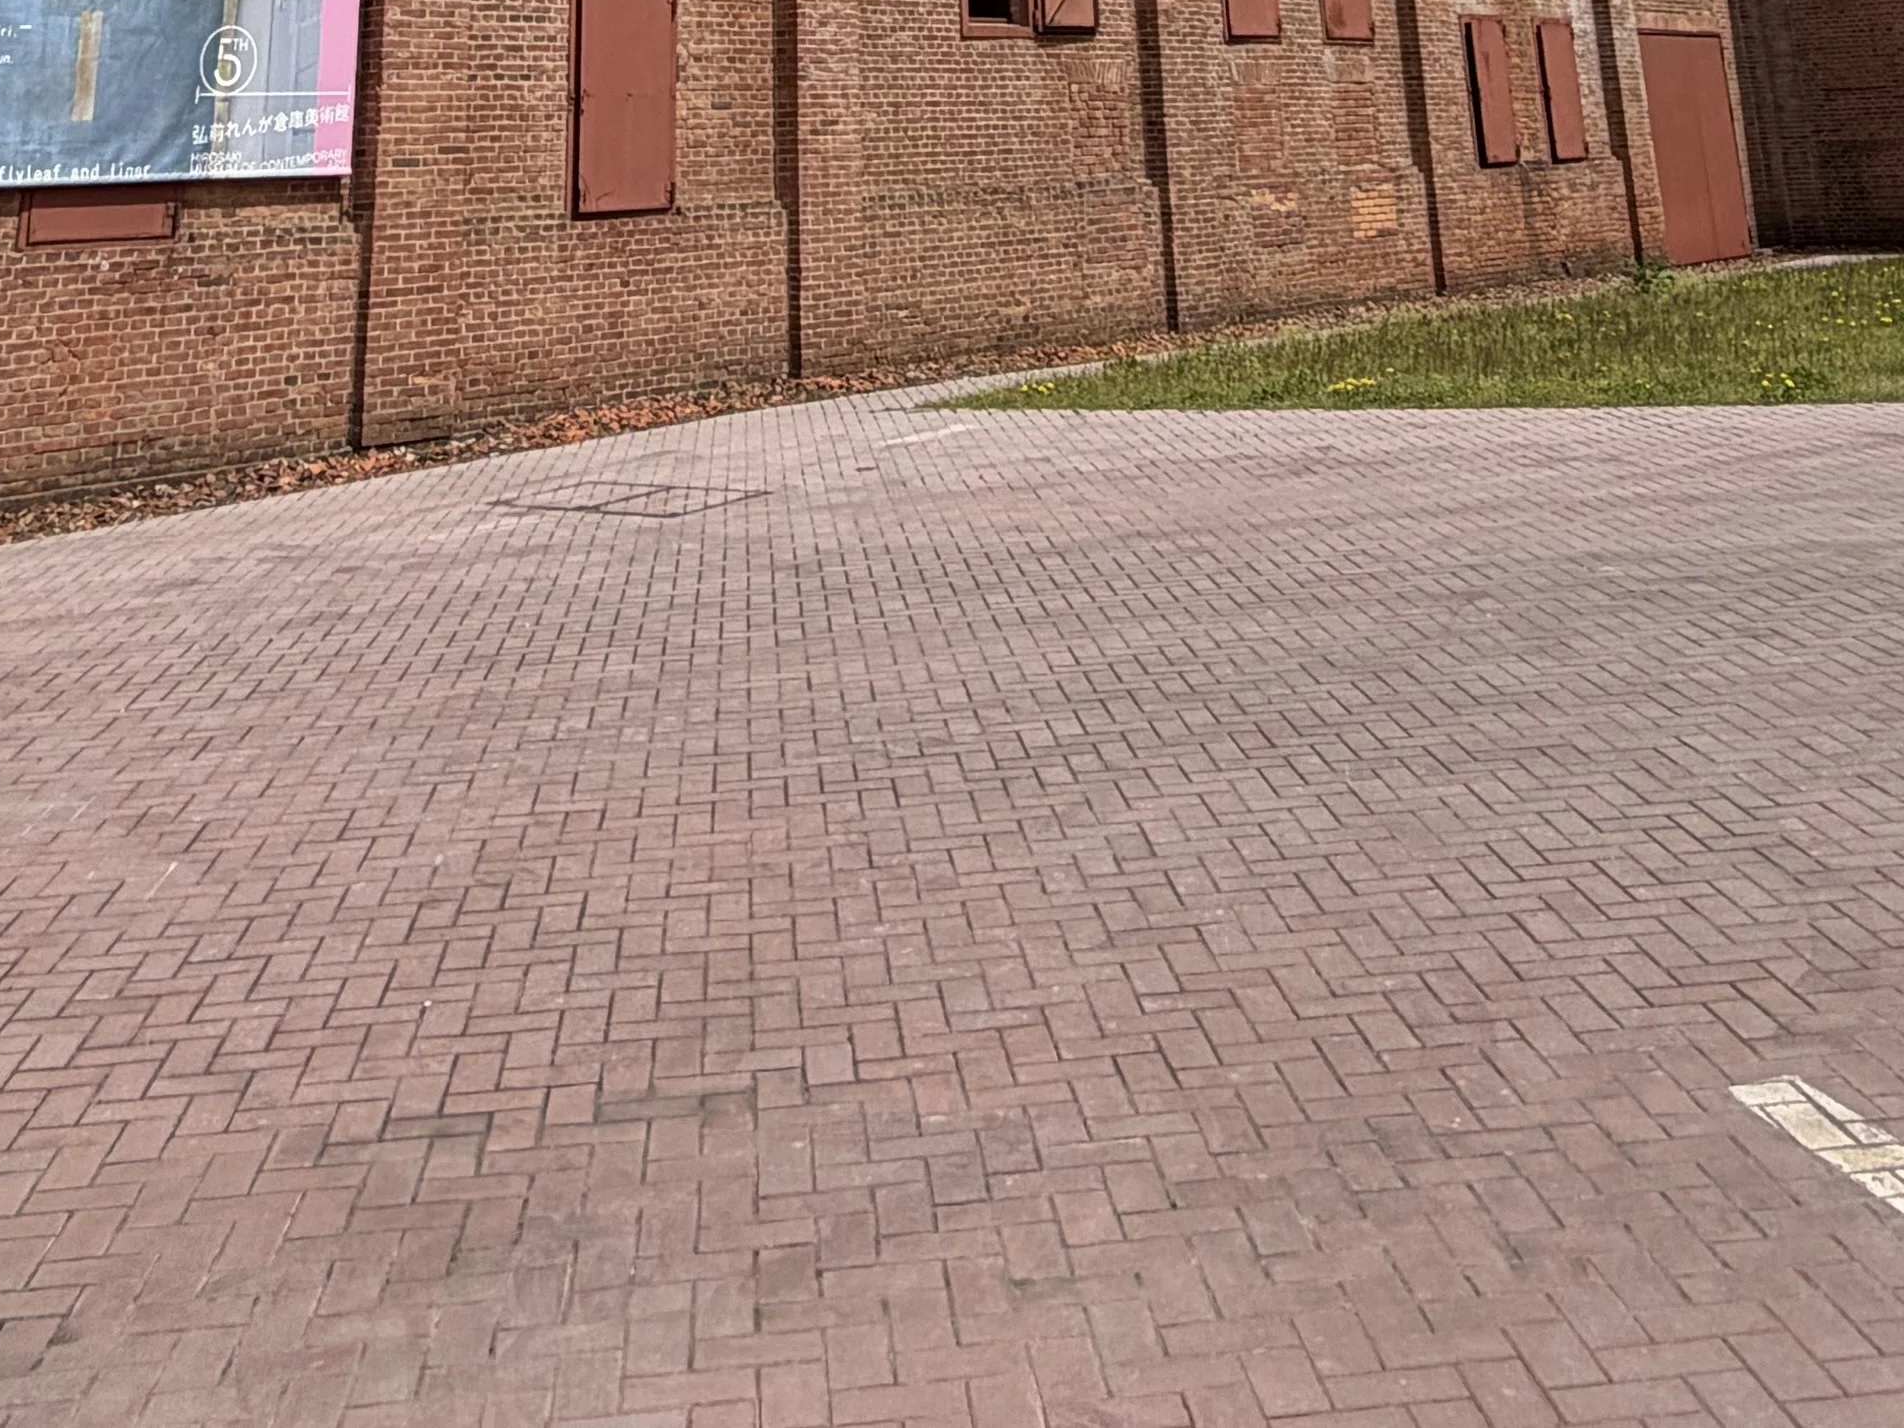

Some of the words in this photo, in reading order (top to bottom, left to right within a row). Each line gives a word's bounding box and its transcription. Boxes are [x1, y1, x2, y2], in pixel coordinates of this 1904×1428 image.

[191, 103, 351, 145] 弘前れんが倉庫美術館
[70, 161, 100, 179] and
[110, 159, 151, 176] liner
